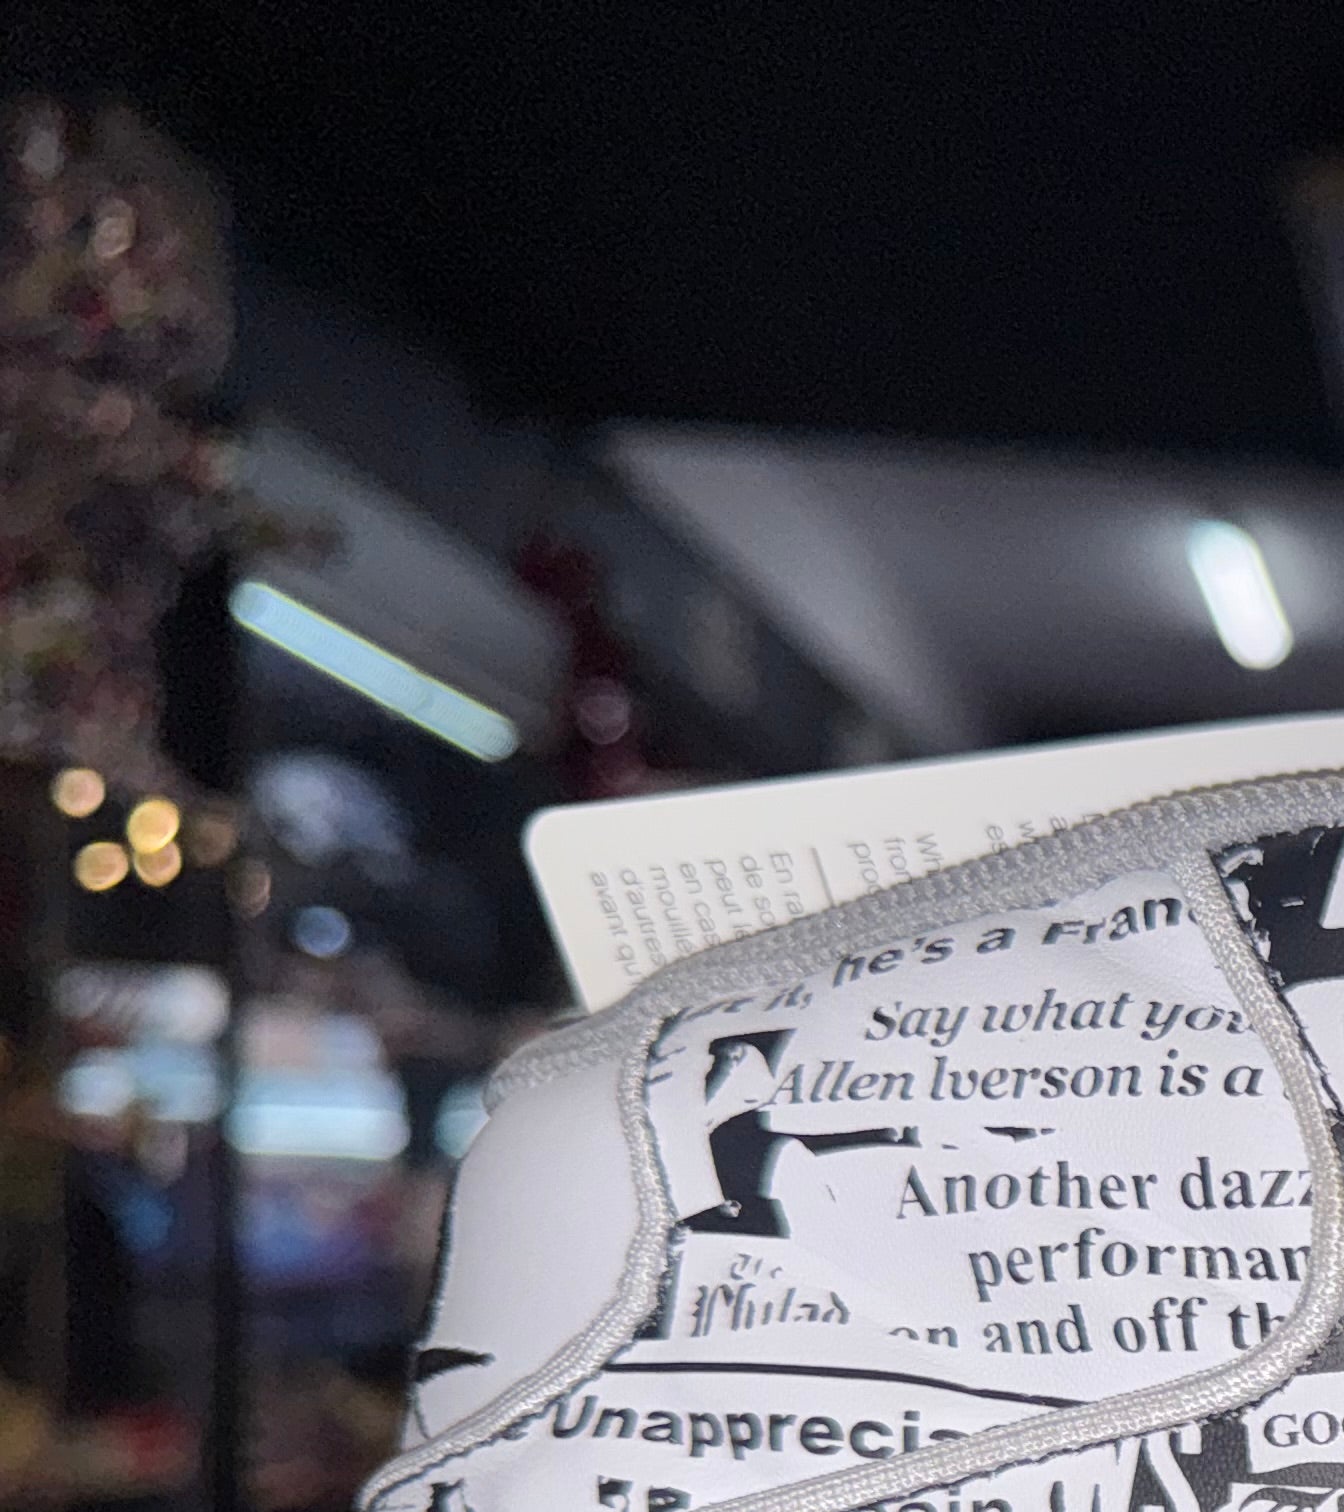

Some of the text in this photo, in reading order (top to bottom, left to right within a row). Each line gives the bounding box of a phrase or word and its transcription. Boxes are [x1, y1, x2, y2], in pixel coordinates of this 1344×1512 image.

[678, 862, 704, 895] en
[704, 859, 745, 915] peut
[739, 855, 764, 889] de
[589, 870, 629, 938] avant
[977, 926, 1016, 955] a
[1042, 896, 1196, 945] Fran
[865, 999, 962, 1048] Say
[984, 989, 1130, 1032] what
[764, 1060, 914, 1106] Allen
[1158, 1048, 1204, 1097] is
[1222, 1063, 1264, 1098] a
[896, 1160, 1157, 1219] Another
[985, 1304, 1091, 1355] and
[1113, 1297, 1205, 1353] off
